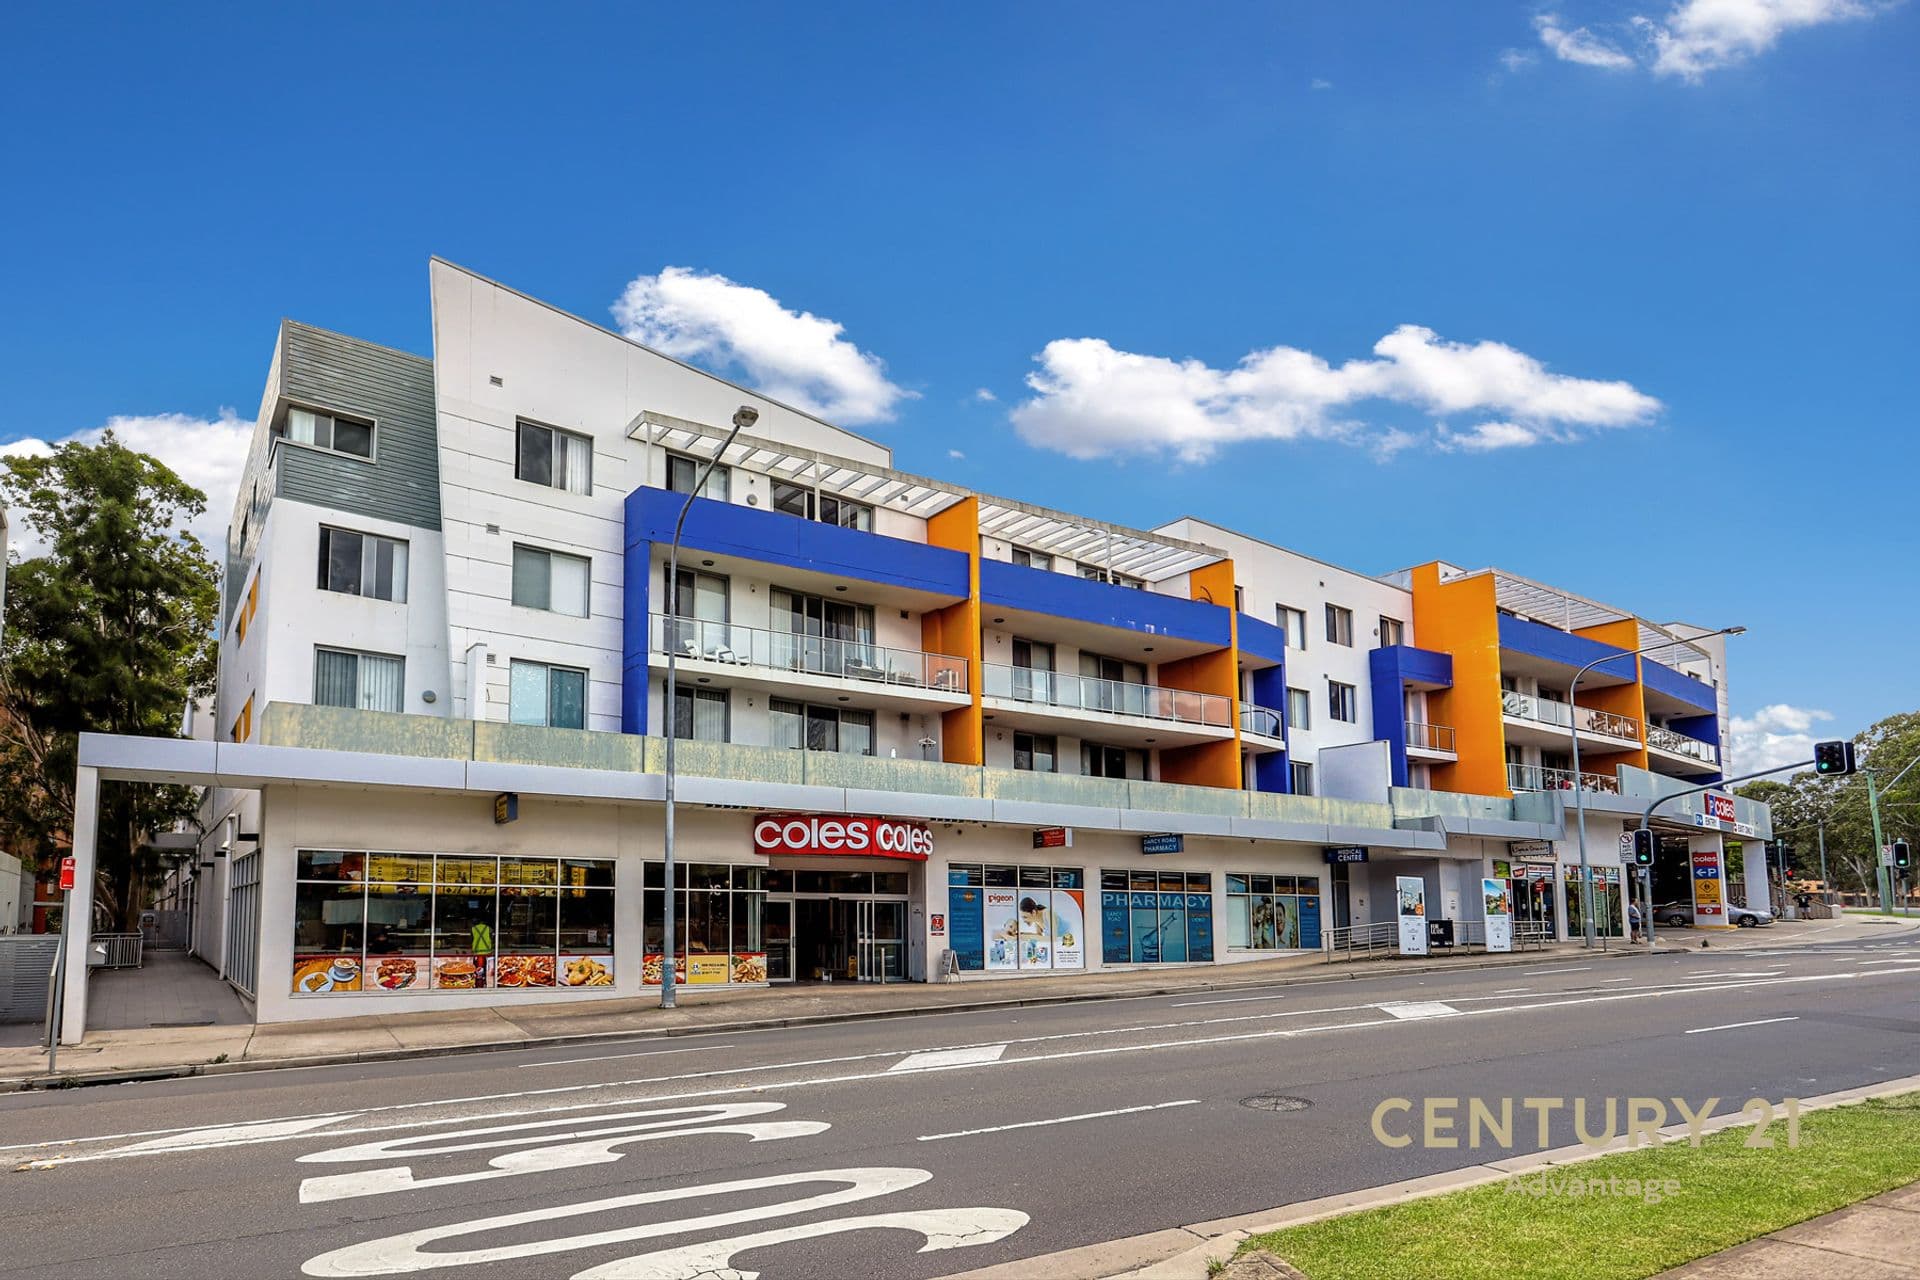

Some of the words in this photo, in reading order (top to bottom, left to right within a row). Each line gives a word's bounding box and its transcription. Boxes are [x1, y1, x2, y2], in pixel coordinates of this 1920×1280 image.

[1715, 800, 1735, 818] coles
[754, 818, 870, 850] coles
[876, 823, 934, 856] coles
[1143, 844, 1177, 852] PHARMACY
[1707, 868, 1717, 877] P
[1102, 893, 1210, 909] PHARMACY
